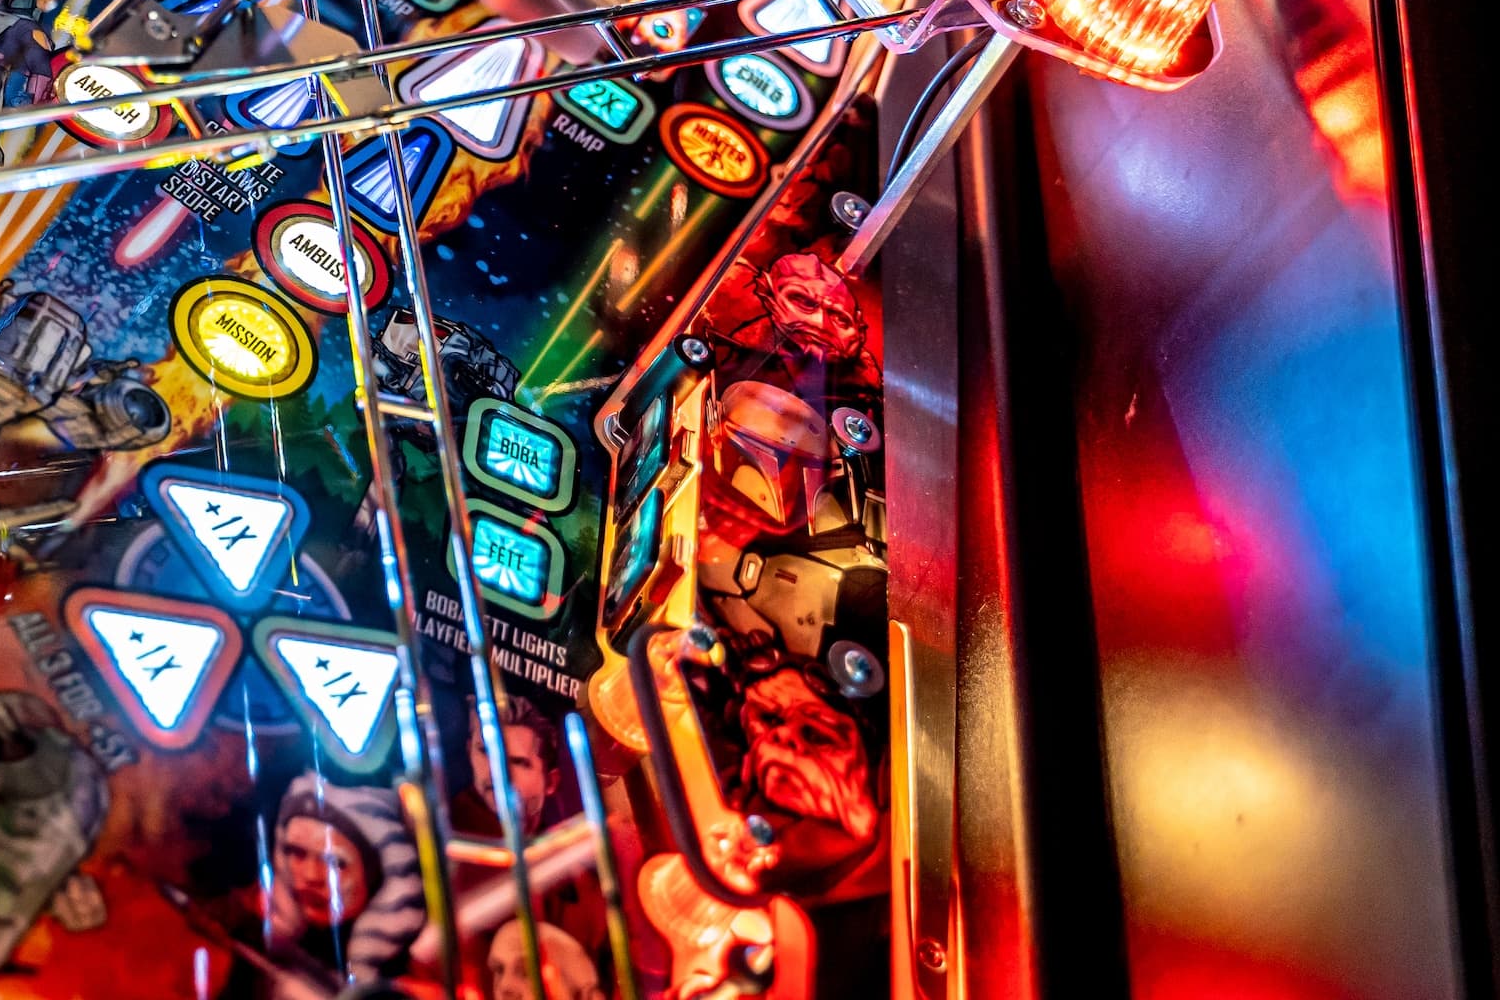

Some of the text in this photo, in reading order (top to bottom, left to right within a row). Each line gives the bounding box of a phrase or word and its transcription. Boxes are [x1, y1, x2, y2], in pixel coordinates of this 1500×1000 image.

[586, 83, 621, 115] 2X
[553, 114, 605, 153] RAMP
[163, 175, 221, 222] SCOPE
[195, 170, 249, 213] START
[289, 234, 346, 281] AMBUS
[215, 313, 277, 362] MISSION
[500, 438, 540, 470] BOBA
[489, 542, 524, 572] FETT
[9, 612, 55, 654] ALL
[512, 626, 567, 667] LIGHTS
[491, 644, 580, 700] MULTIPLIER
